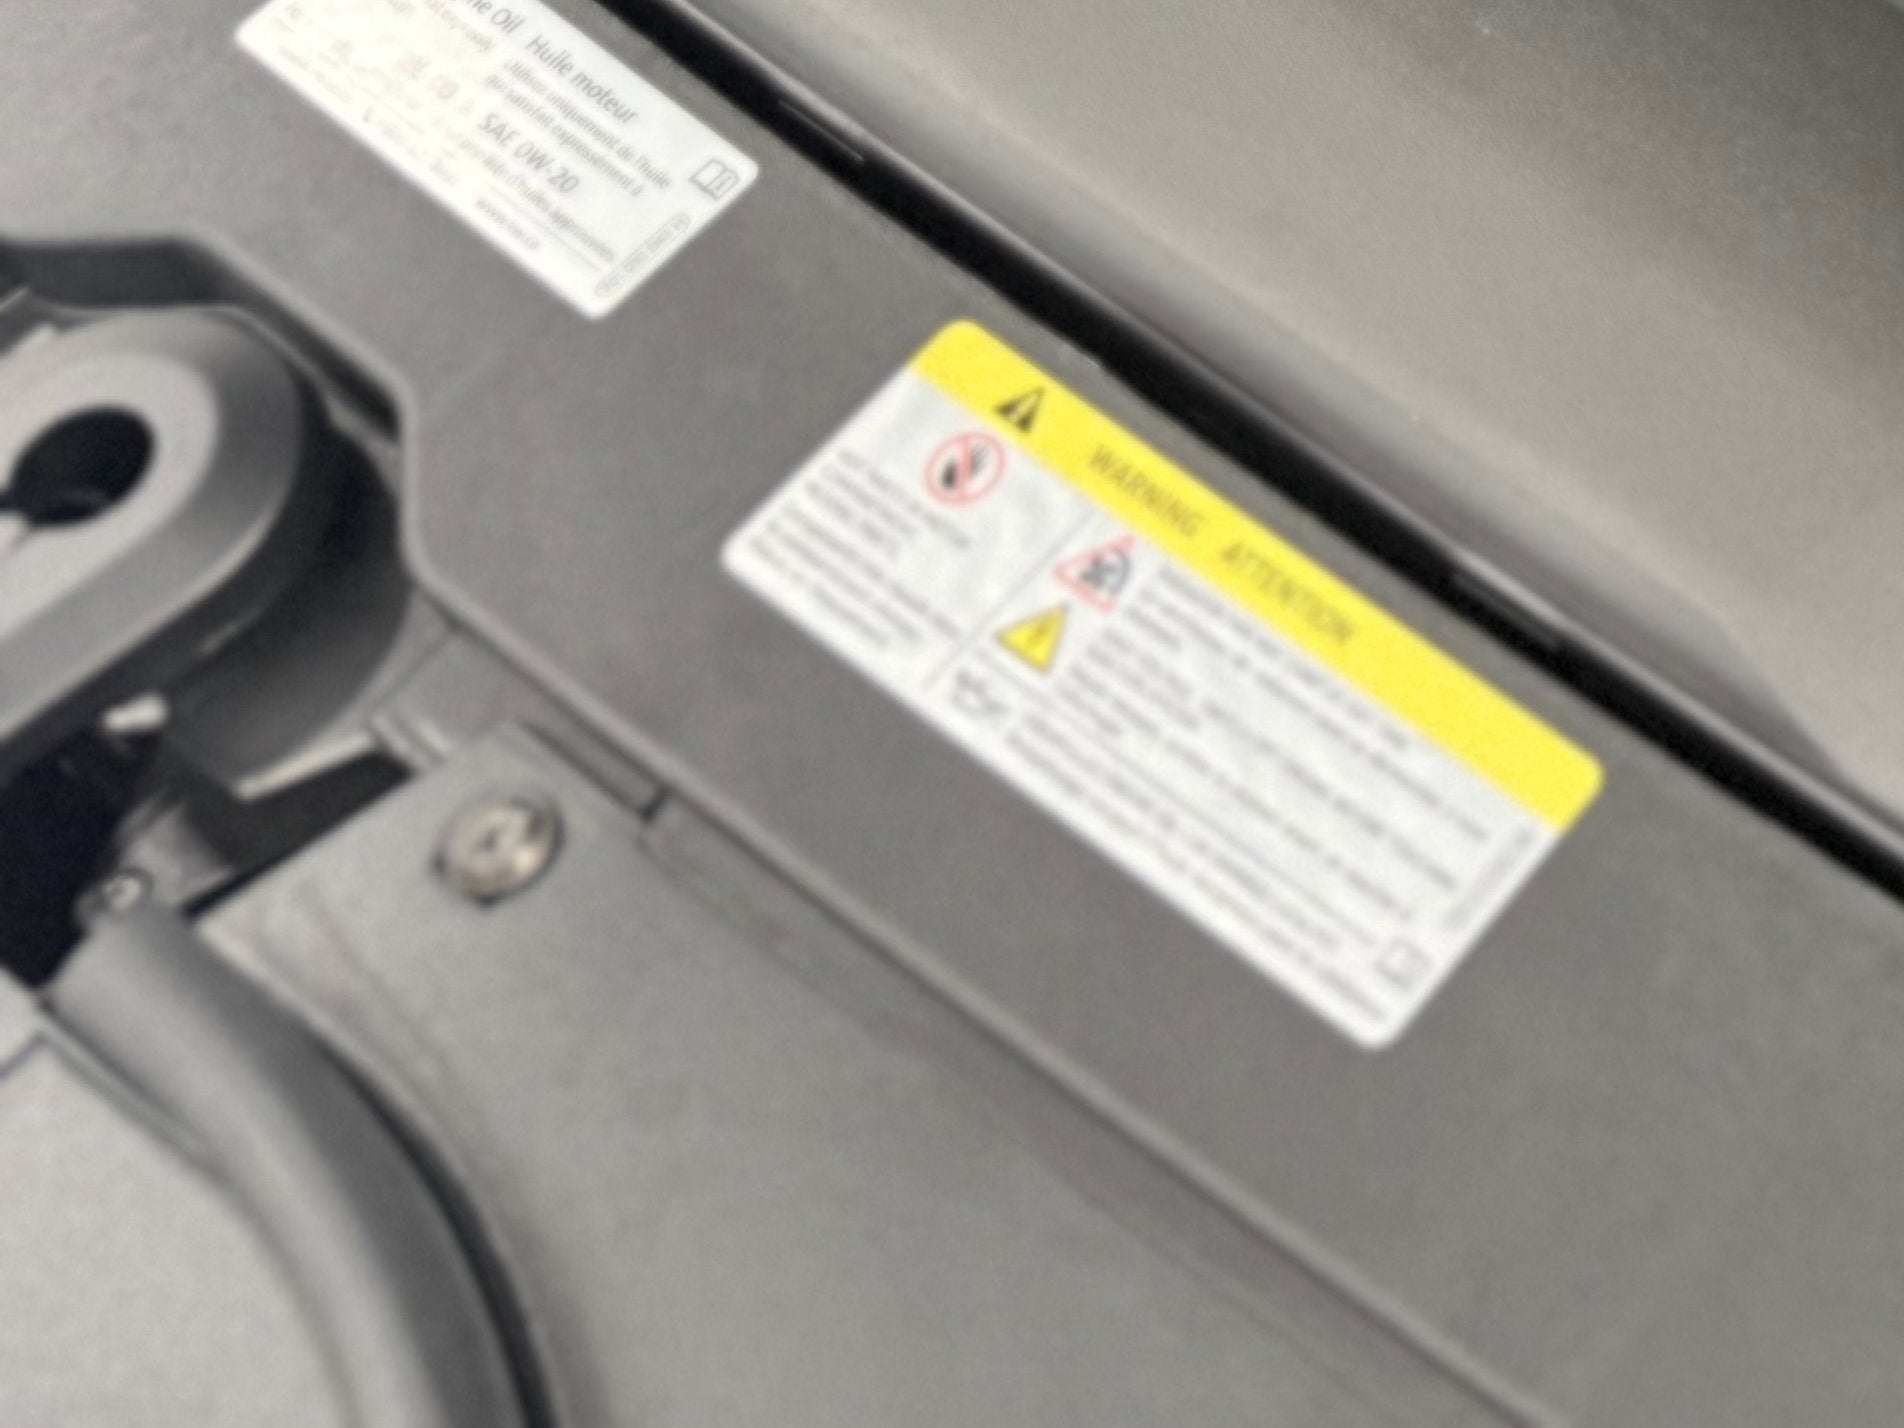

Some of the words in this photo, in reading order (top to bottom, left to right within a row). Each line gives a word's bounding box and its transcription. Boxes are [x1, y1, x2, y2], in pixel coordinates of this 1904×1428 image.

[486, 4, 526, 36] Oil
[523, 31, 582, 78] Huile
[566, 66, 644, 127] moteur
[475, 110, 522, 149] SAE
[510, 137, 584, 197] 0W-20
[1081, 442, 1210, 541] WARNING
[1213, 537, 1364, 652] ATTENTION
